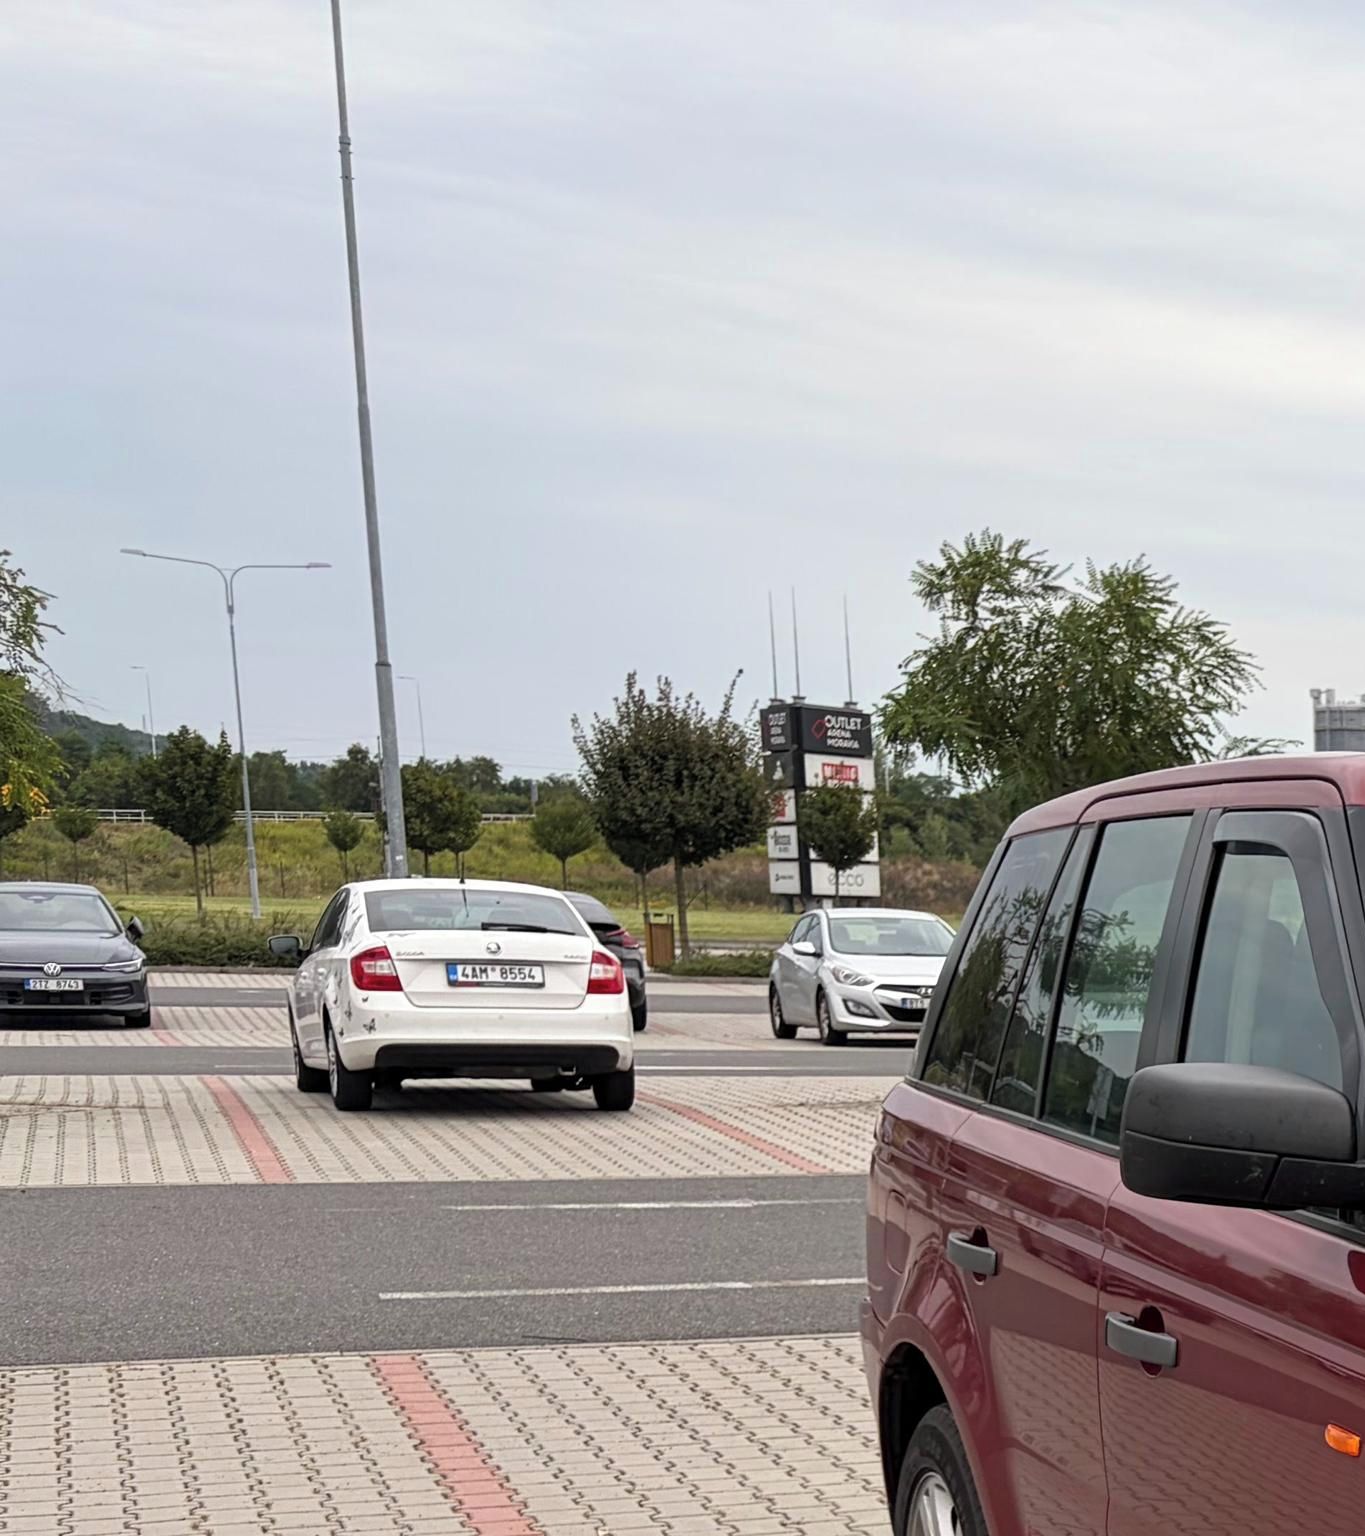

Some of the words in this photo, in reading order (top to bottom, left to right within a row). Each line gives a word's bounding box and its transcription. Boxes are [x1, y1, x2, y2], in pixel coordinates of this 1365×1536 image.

[824, 715, 862, 730] OUTLET
[461, 966, 489, 980] 4AM
[500, 967, 536, 981] 8554
